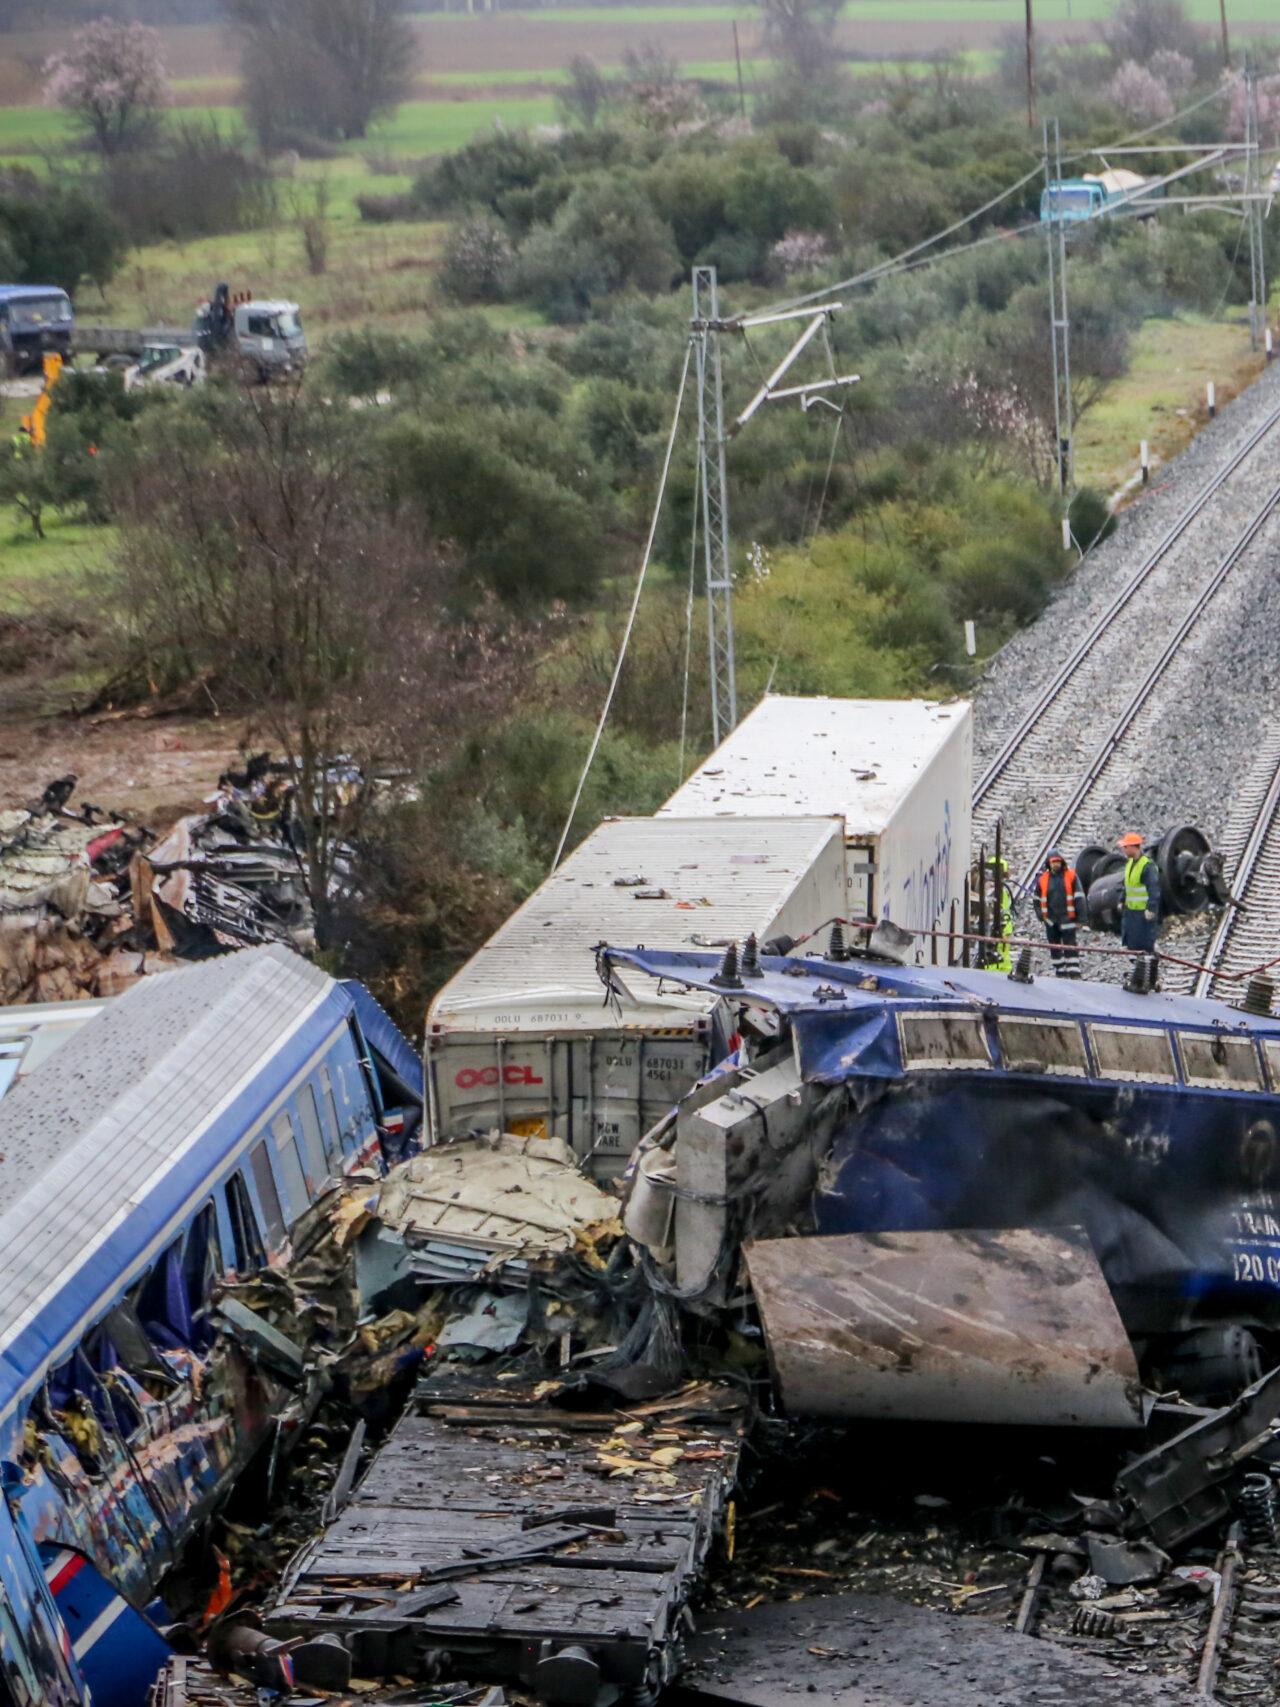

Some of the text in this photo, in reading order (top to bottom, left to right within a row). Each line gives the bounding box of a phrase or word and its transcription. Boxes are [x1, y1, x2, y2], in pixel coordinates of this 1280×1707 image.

[530, 1013, 568, 1023] 687031
[646, 1058, 684, 1069] 687031
[455, 1065, 543, 1089] OOCL
[646, 1070, 671, 1080] 4561
[1234, 1252, 1265, 1281] 120
